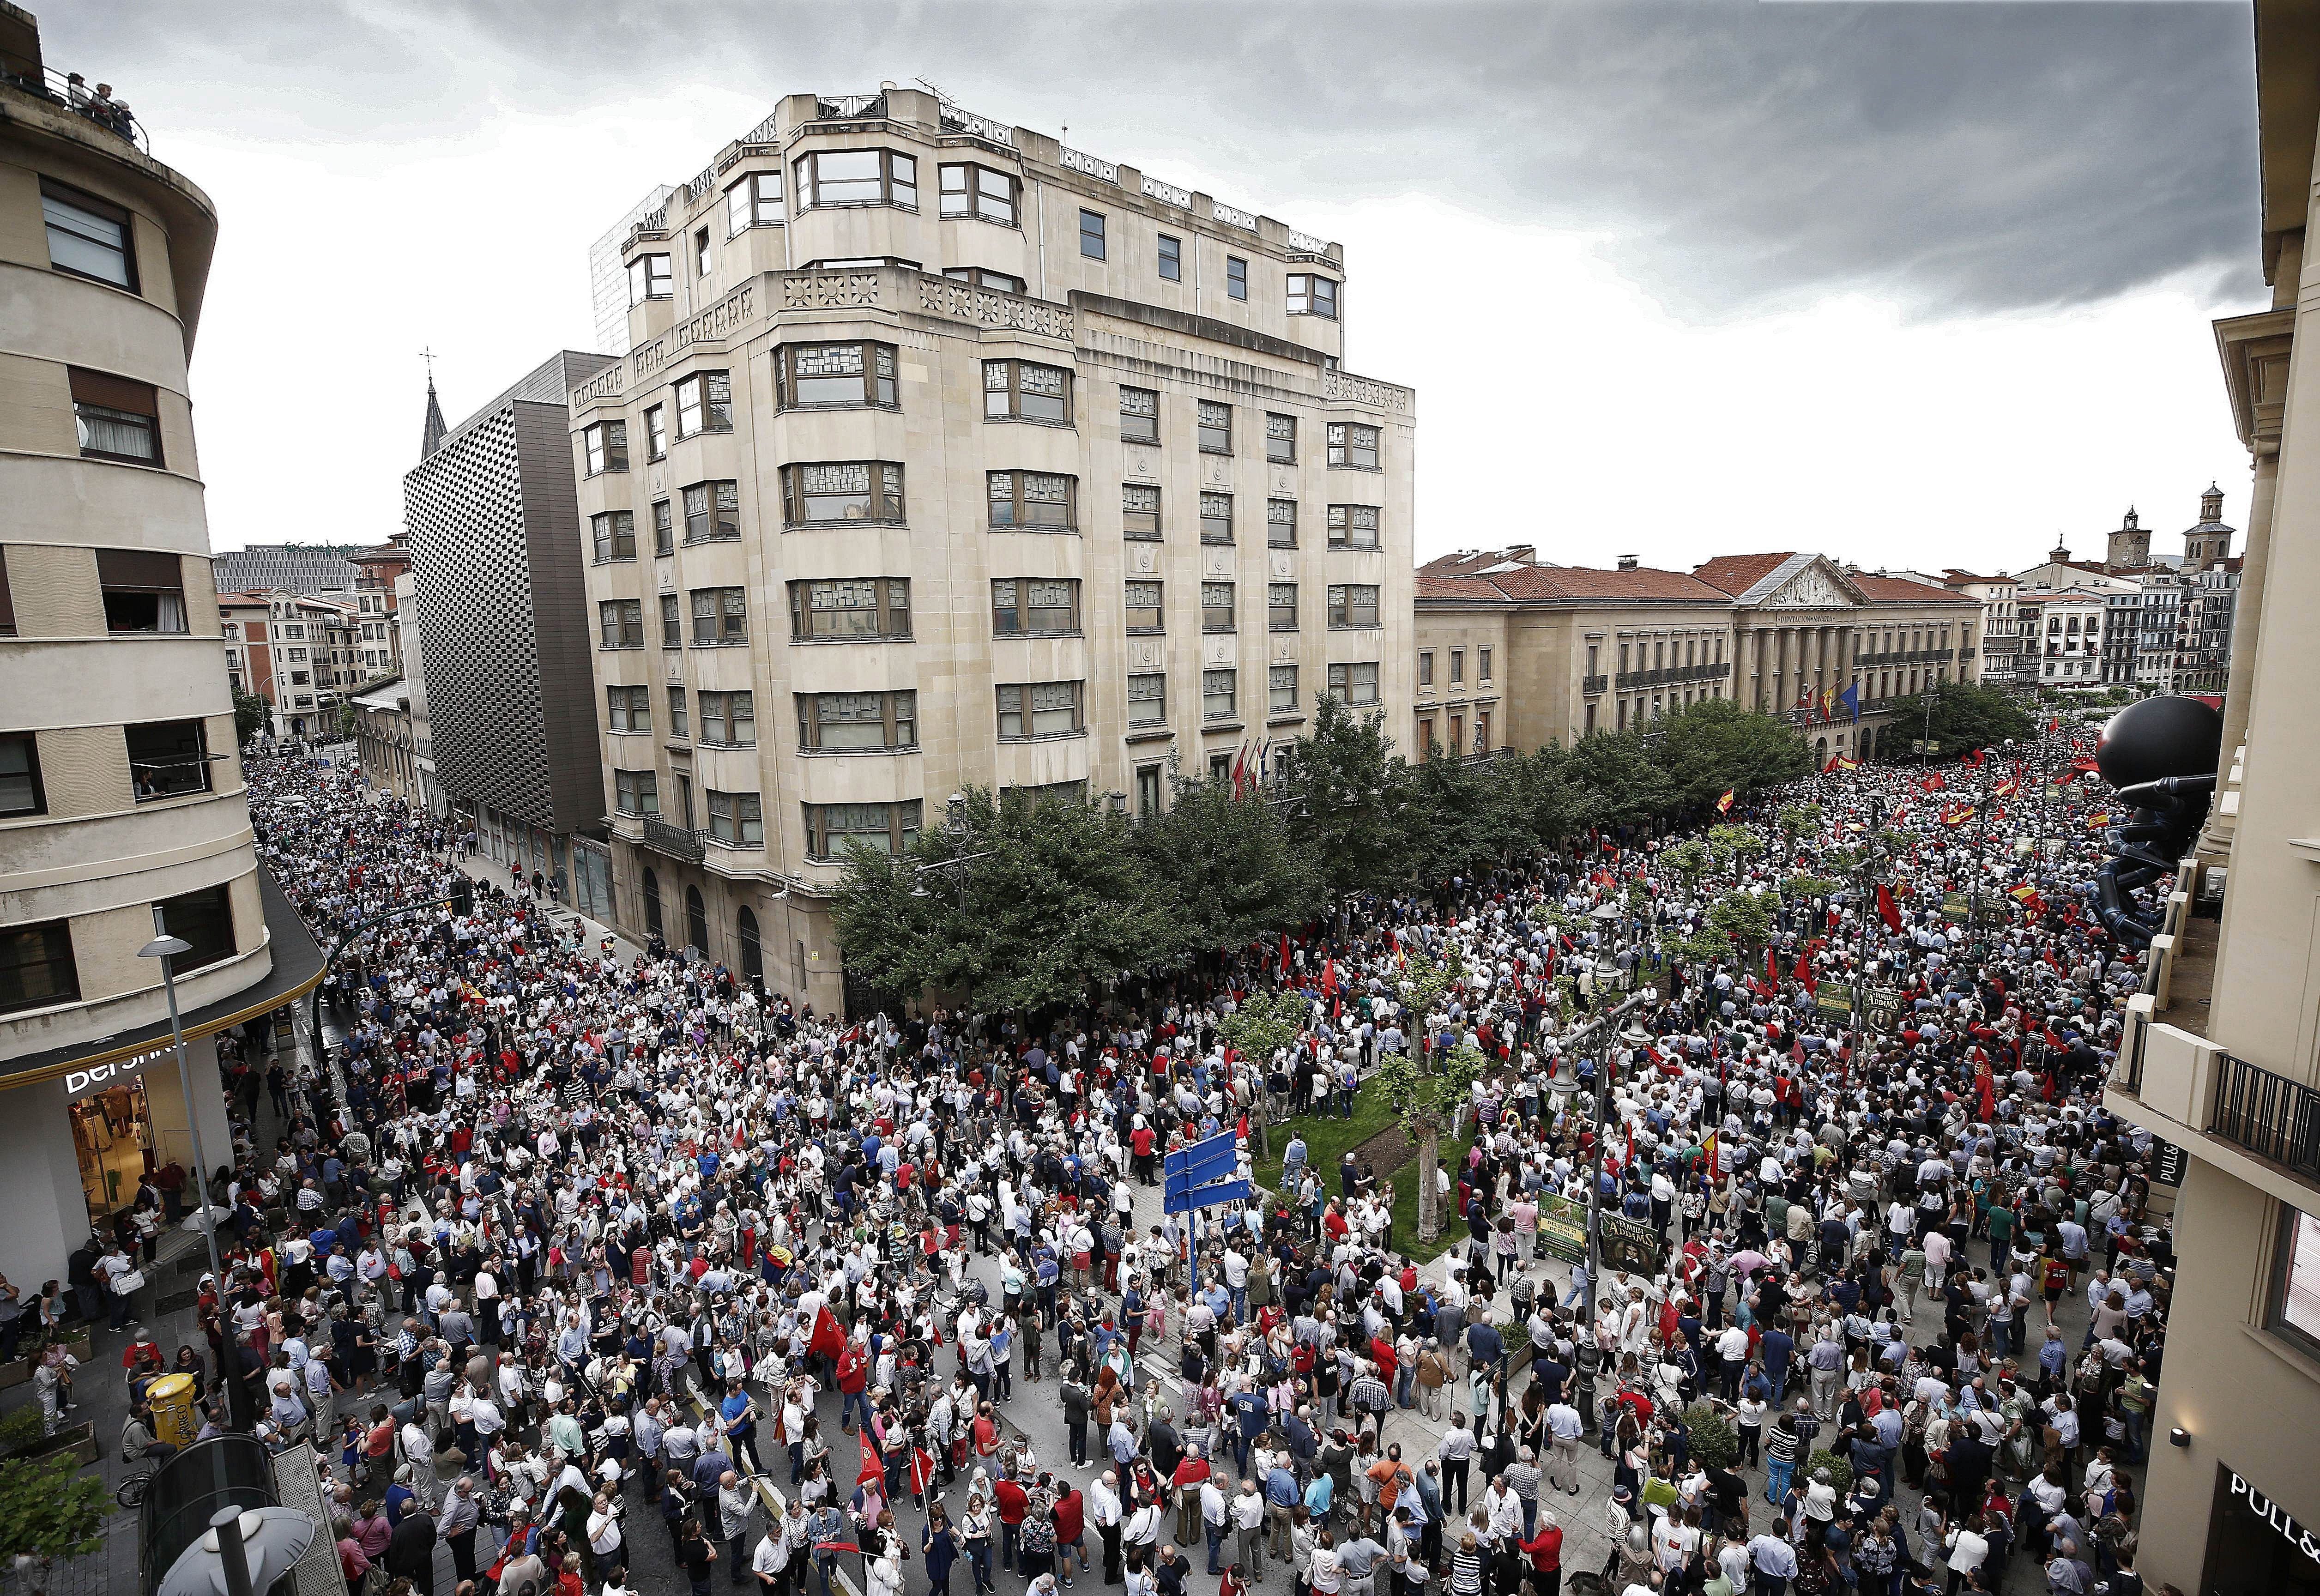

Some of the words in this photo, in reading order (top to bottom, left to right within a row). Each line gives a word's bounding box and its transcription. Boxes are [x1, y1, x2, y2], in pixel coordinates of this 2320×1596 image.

[1982, 900, 2006, 911] ADDAMS
[1868, 993, 1899, 1010] ADDAMS
[2160, 1140, 2179, 1182] PULL&
[1540, 1209, 1559, 1220] TEATRO
[1560, 1216, 1584, 1229] GAYARRE
[1619, 1219, 1644, 1234] FAMILIA
[1558, 1229, 1574, 1238] JUNIO
[1608, 1220, 1654, 1248] ADDAMS
